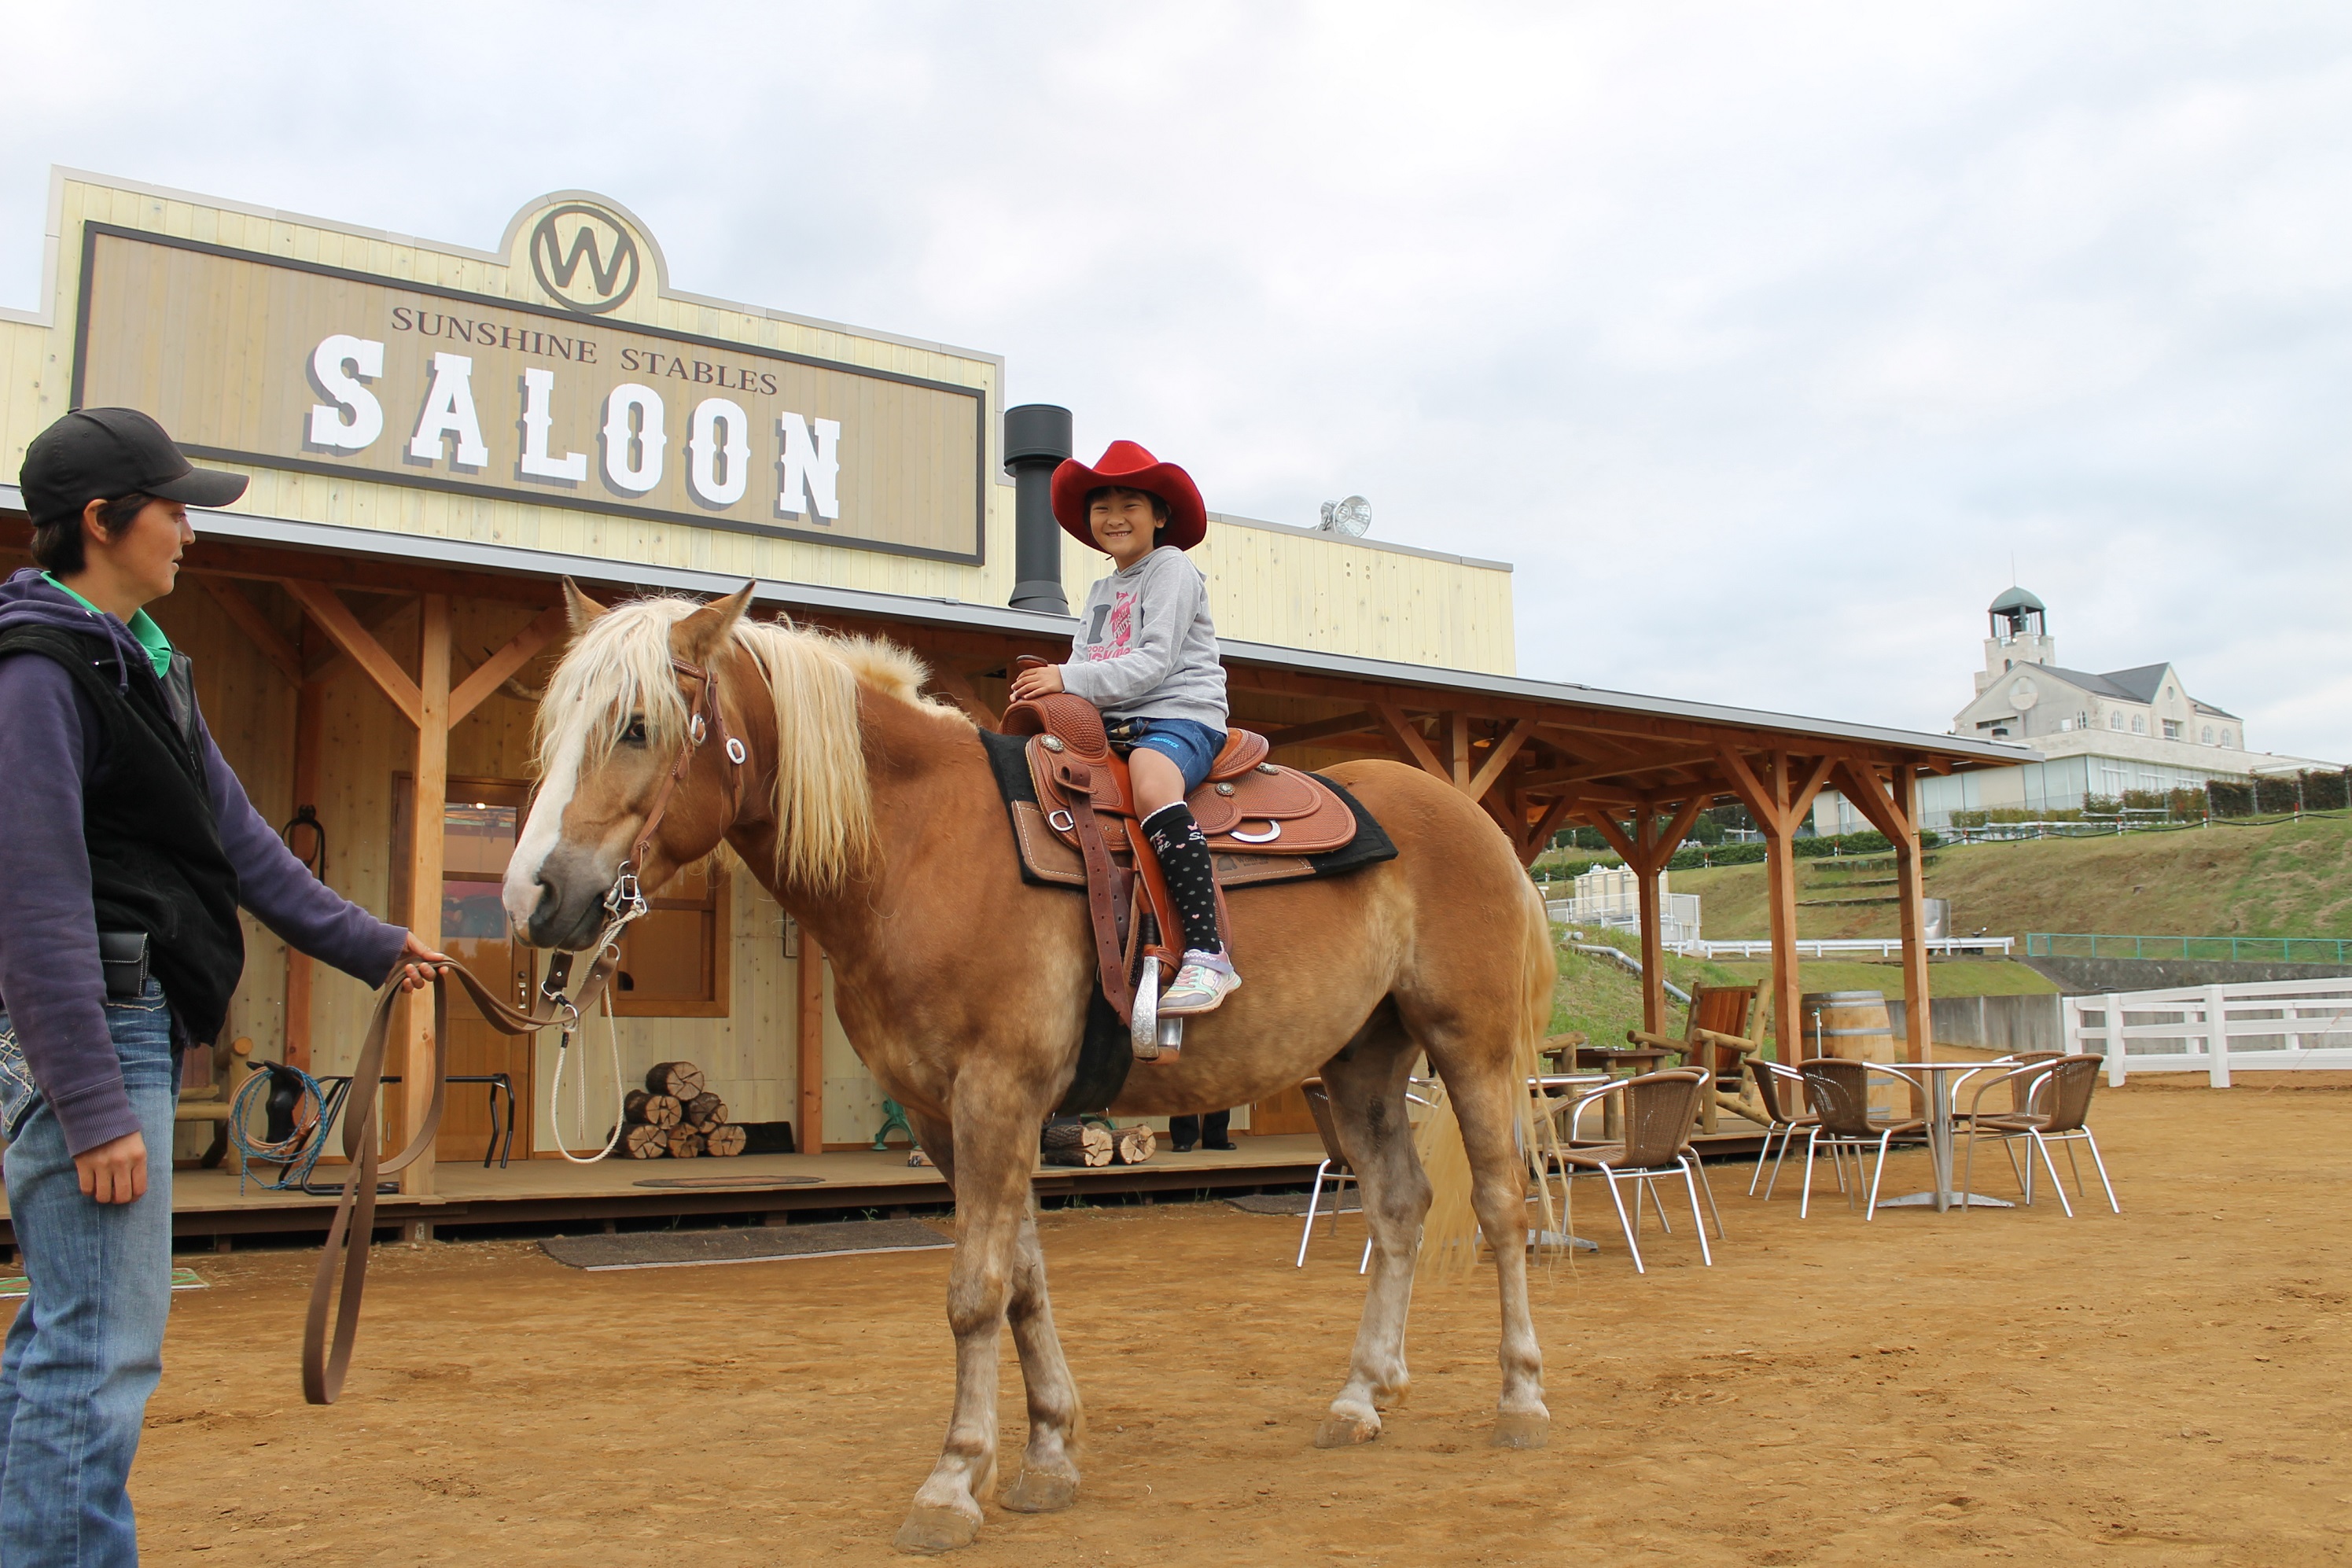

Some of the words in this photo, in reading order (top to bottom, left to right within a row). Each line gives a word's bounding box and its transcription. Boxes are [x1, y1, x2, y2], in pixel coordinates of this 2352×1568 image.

[539, 211, 629, 296] W
[392, 307, 598, 363] SUNSHINE
[620, 348, 778, 395] STABLES
[307, 334, 841, 521] SALOON
